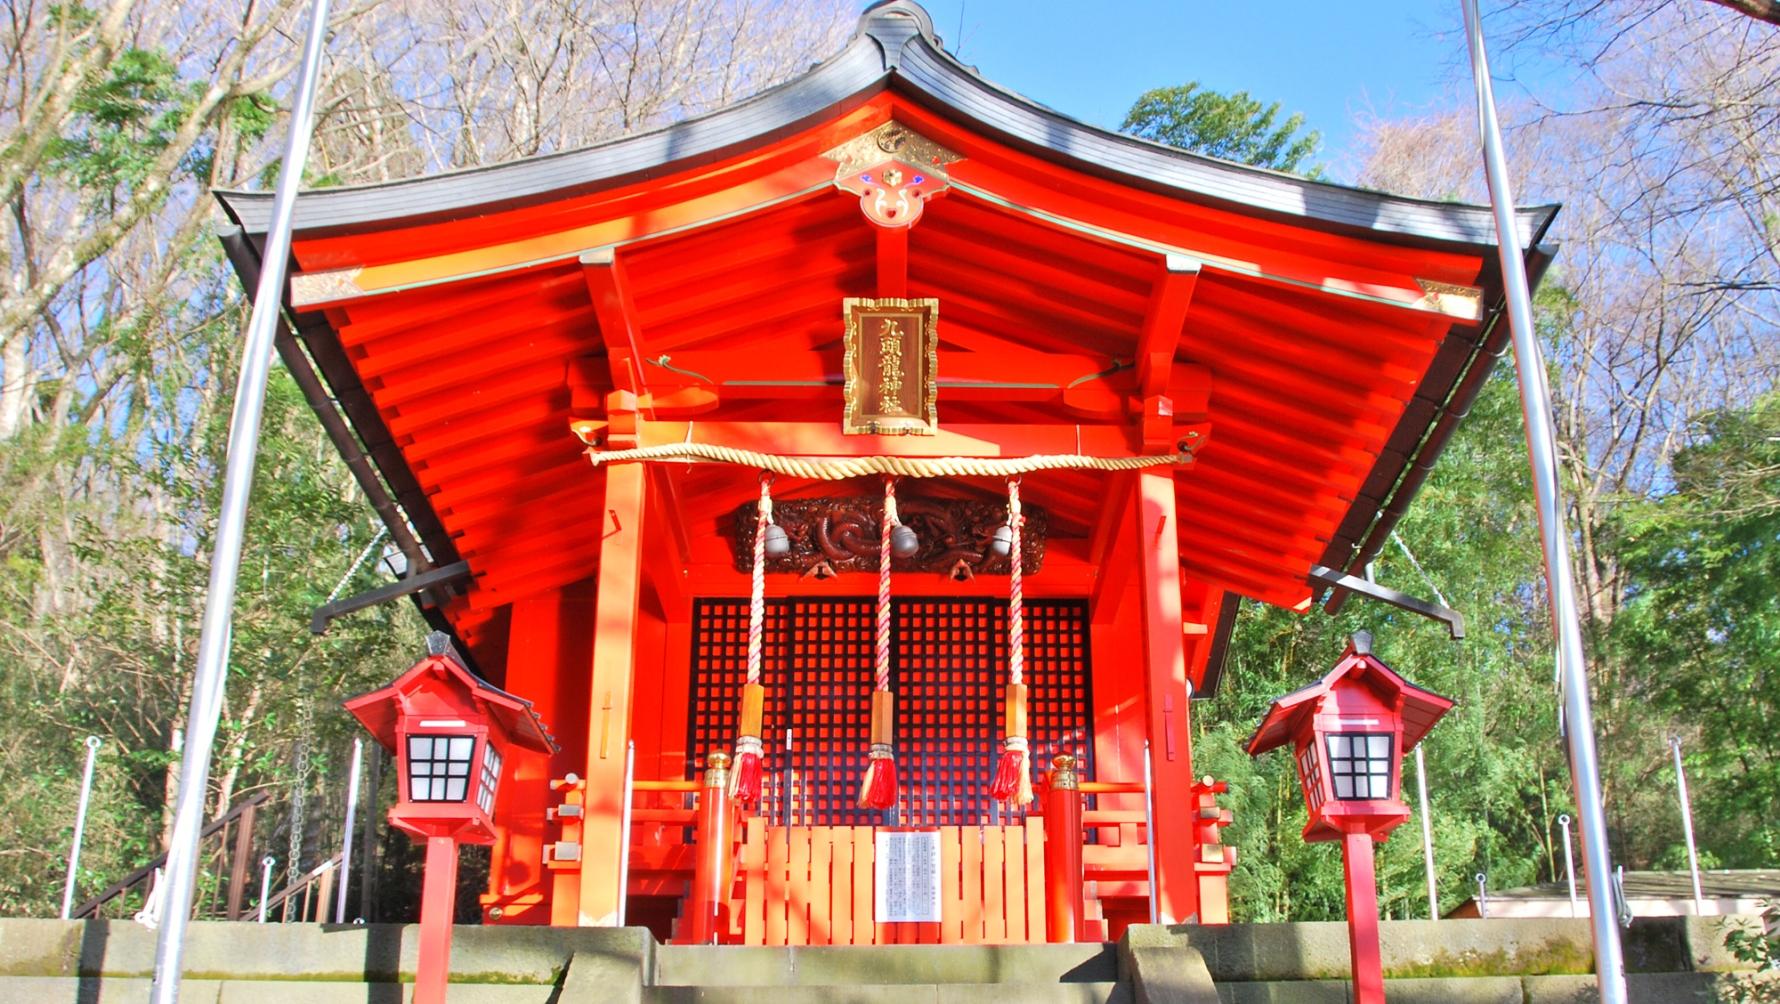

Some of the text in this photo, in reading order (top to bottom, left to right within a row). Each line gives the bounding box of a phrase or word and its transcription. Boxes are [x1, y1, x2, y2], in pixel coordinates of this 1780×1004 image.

[879, 318, 904, 414] 九頭龍神社
